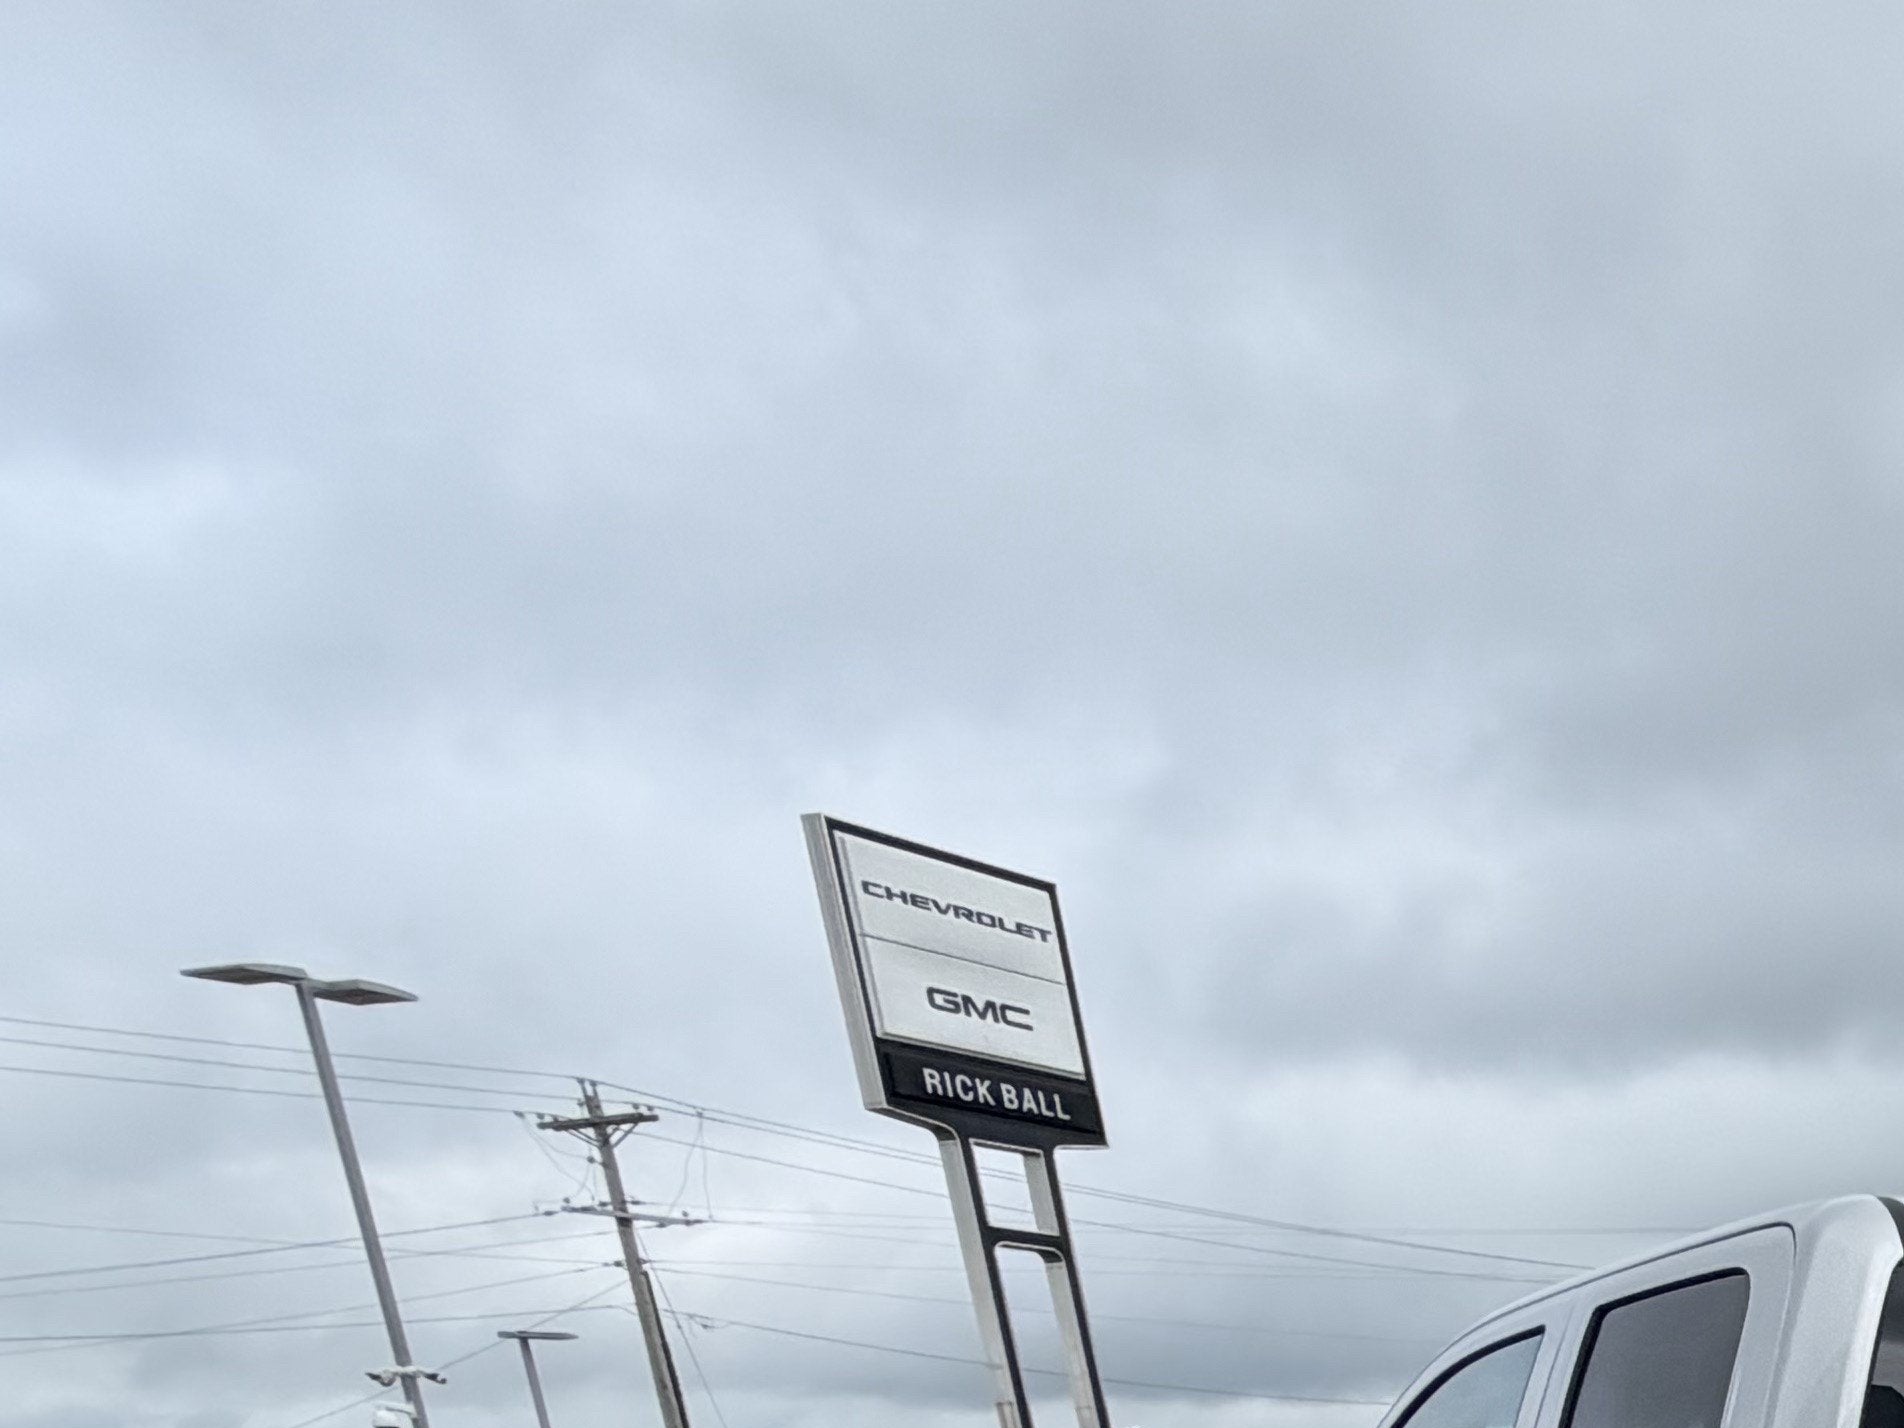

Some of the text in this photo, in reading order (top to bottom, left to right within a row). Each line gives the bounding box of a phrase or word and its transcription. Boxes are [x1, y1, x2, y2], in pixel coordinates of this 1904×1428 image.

[861, 880, 1052, 943] CHEVROLET
[926, 986, 1033, 1032] GMC
[922, 1067, 1071, 1121] RICK BALL
